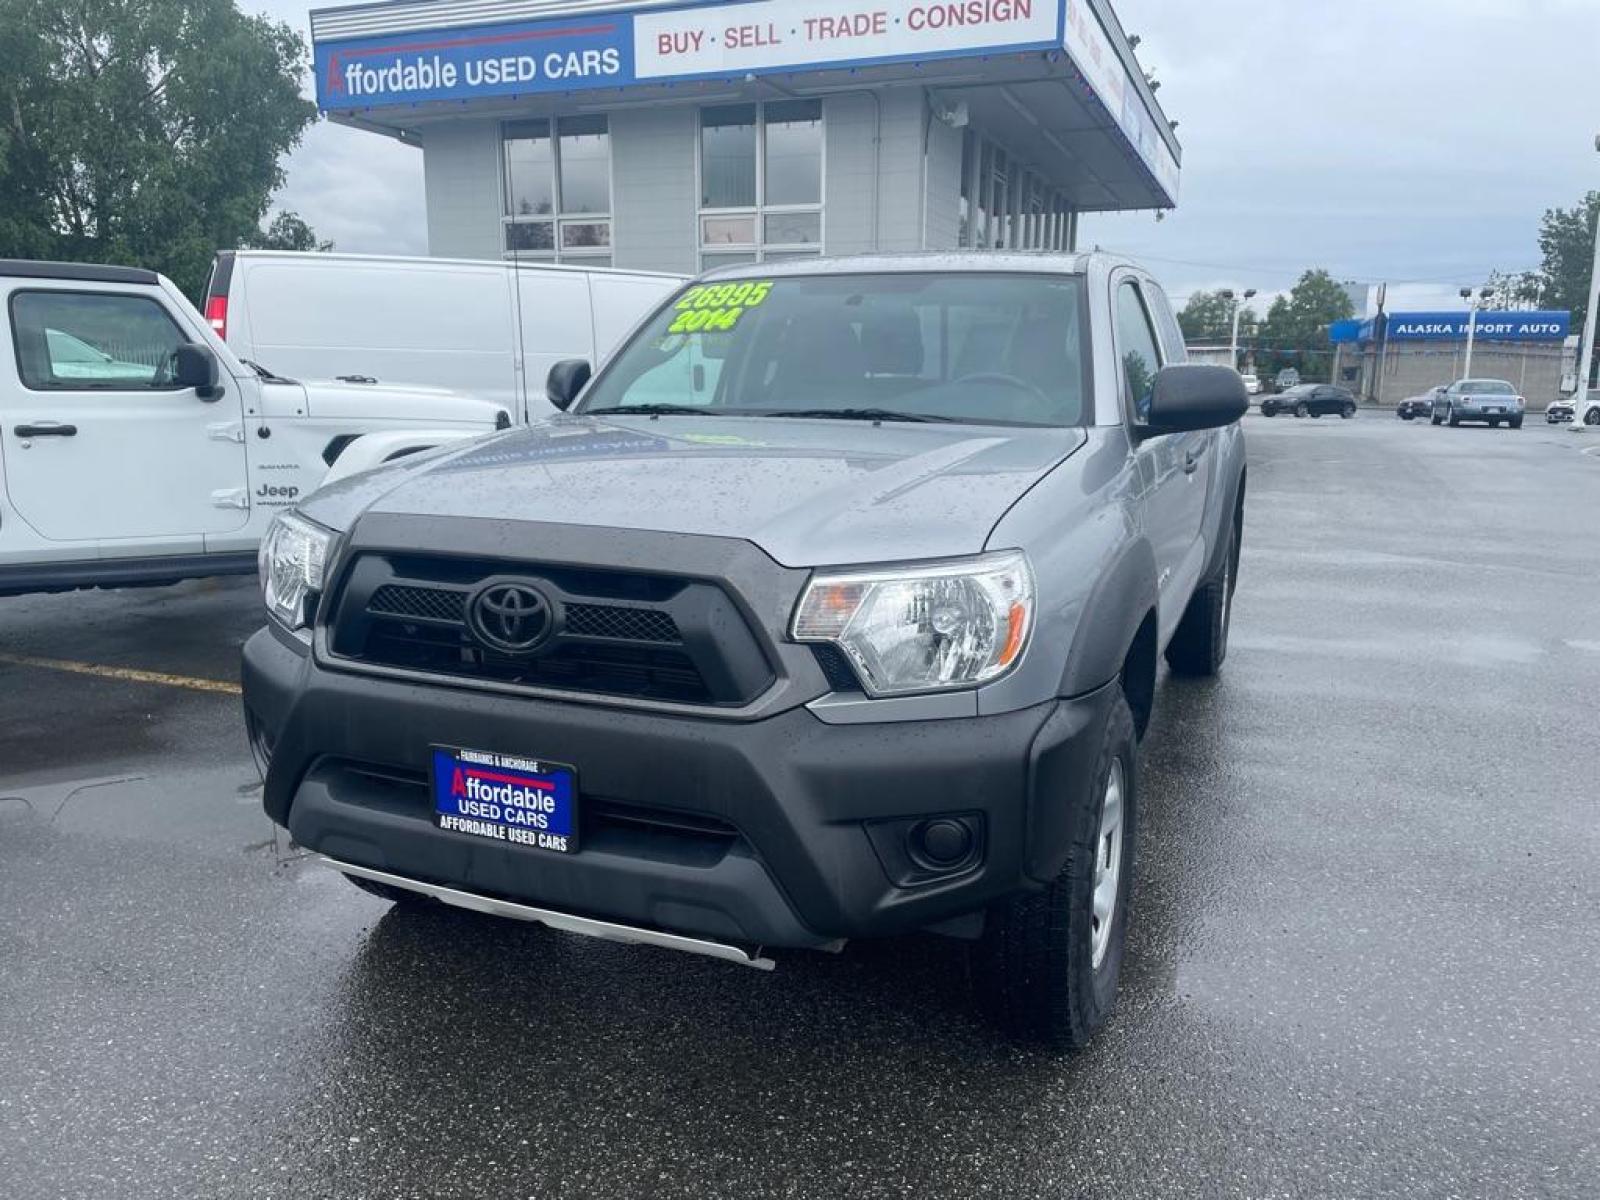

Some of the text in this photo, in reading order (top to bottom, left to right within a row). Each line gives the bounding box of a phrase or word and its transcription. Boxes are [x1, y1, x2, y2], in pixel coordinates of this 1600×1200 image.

[658, 0, 1032, 55] BUY SELL TRADE CONSIGN
[326, 47, 620, 96] Affordable USED CARS
[675, 282, 774, 309] 26995
[668, 308, 742, 333] 2014
[1396, 323, 1453, 334] ALASKA
[1519, 323, 1561, 334] AUTO
[256, 484, 299, 499] Jeep
[452, 767, 556, 813] Affordable
[458, 799, 549, 829] USED CARS
[440, 815, 568, 852] AFFORDABLE USED CARS
